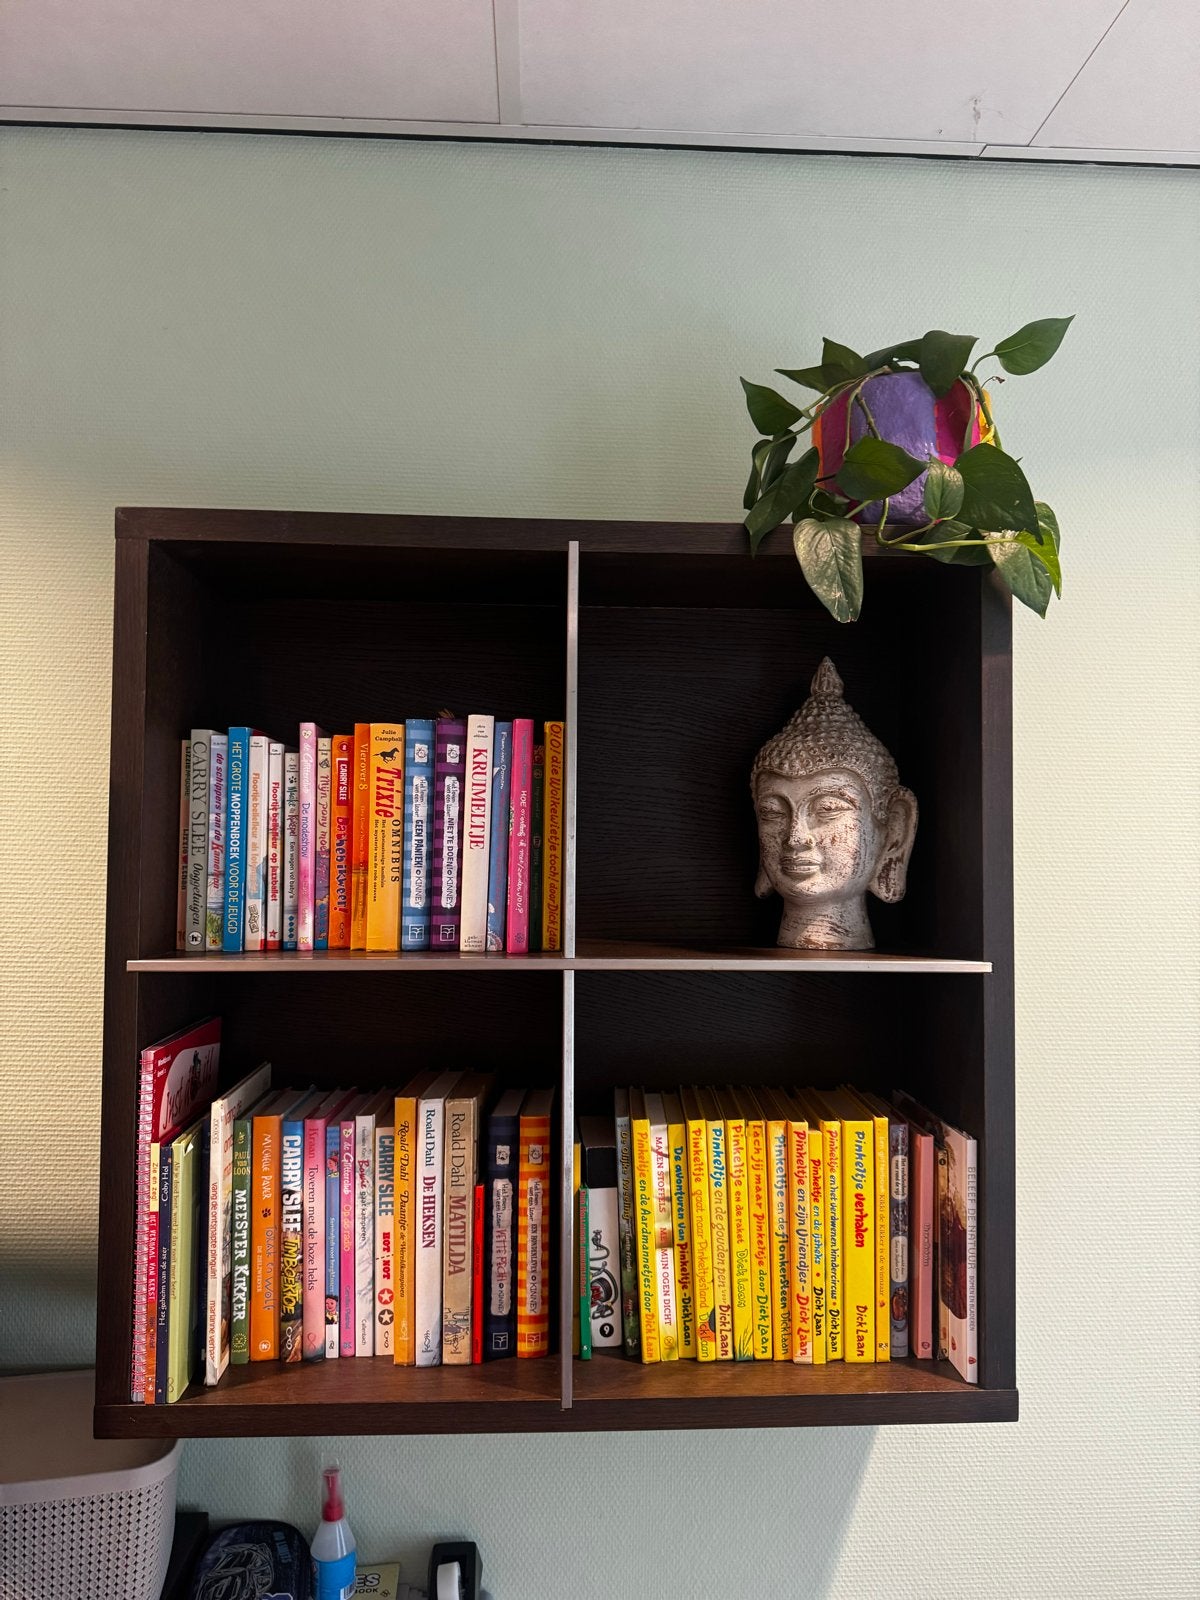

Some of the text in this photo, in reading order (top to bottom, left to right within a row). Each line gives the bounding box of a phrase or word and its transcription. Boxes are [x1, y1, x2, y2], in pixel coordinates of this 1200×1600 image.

[214, 766, 224, 810] schippers
[216, 753, 224, 765] de
[251, 772, 260, 802] Floortje
[339, 764, 348, 801] CARRY SLEE
[192, 741, 207, 856] CARRY SLEE
[318, 774, 330, 828] Mijn pony
[376, 766, 402, 818] Trixie
[469, 748, 488, 850] KRUIMELTJE
[228, 742, 242, 934] HET GROTE MOPPENBOEK VOOR DE JEUGD
[270, 782, 280, 902] Floortje op jazzballet
[301, 802, 310, 858] De modeshow
[391, 820, 401, 883] OMNIBUS
[414, 820, 424, 868] GEEN PANIEK!
[446, 846, 454, 870] DOEN!
[548, 755, 561, 925] die Wolkewietje door Dick
[190, 863, 203, 926] Ooggetuigen
[212, 841, 224, 890] Kameleon
[414, 876, 423, 906] KINNEY
[445, 876, 454, 906] KINNEY
[262, 1133, 272, 1200] MICHELLE PAVER
[308, 1128, 318, 1159] Kraan
[398, 1120, 410, 1182] Roald Dahl
[425, 1109, 436, 1166] Roald Dahl
[450, 1112, 466, 1188] Roald Dahl
[692, 1128, 704, 1183] Pinkeltje
[852, 1130, 866, 1190] Pinkeltje
[162, 1181, 170, 1202] Coby
[234, 1168, 250, 1176] LOON
[282, 1135, 302, 1232] CARRY SLEE
[343, 1152, 354, 1195] Glitterclub
[378, 1135, 394, 1216] CARRY SLEE
[620, 1148, 632, 1221] Olijke Tweeling
[658, 1171, 666, 1213] STOFFELS
[730, 1124, 744, 1244] Pinkeltje raket
[210, 1211, 218, 1249] ontsnapte
[234, 1189, 248, 1260] MEESTER
[308, 1164, 318, 1291] Toveren met de boze heks
[398, 1190, 409, 1231] Daantje
[422, 1195, 436, 1248] HEKSEN
[448, 1194, 466, 1276] MATILDA
[674, 1146, 690, 1290] De avonturen van Pinkeltje
[968, 1166, 976, 1270] BELEEF DE NATUUR
[162, 1260, 168, 1272] de
[266, 1226, 276, 1256] TORAK
[382, 1232, 390, 1280] HOT NOT
[496, 1256, 507, 1282] PECH
[636, 1132, 656, 1358] Pinkeltje Aardmannetjes door Dick Laan
[710, 1128, 732, 1358] Pinkeltje gouden Dick Laan
[736, 1249, 748, 1277] Dick
[753, 1174, 770, 1354] maar Pinkeltje door Dick Laan
[774, 1135, 792, 1355] Pinkeltje Dick Laan
[793, 1130, 810, 1356] Pinkeltje zijn Dick Laan
[810, 1158, 824, 1336] Pinkeltje Dick Laan
[826, 1130, 840, 1352] Pinkeltje kindercircus Dick Laan
[232, 1264, 250, 1322] KIKKER
[282, 1237, 300, 1315] TIMBOEKTOE
[661, 1248, 672, 1326] MIJN OGEN DICHT
[697, 1240, 710, 1308] Pinkeltjesland
[856, 1304, 868, 1357] Dick Laan
